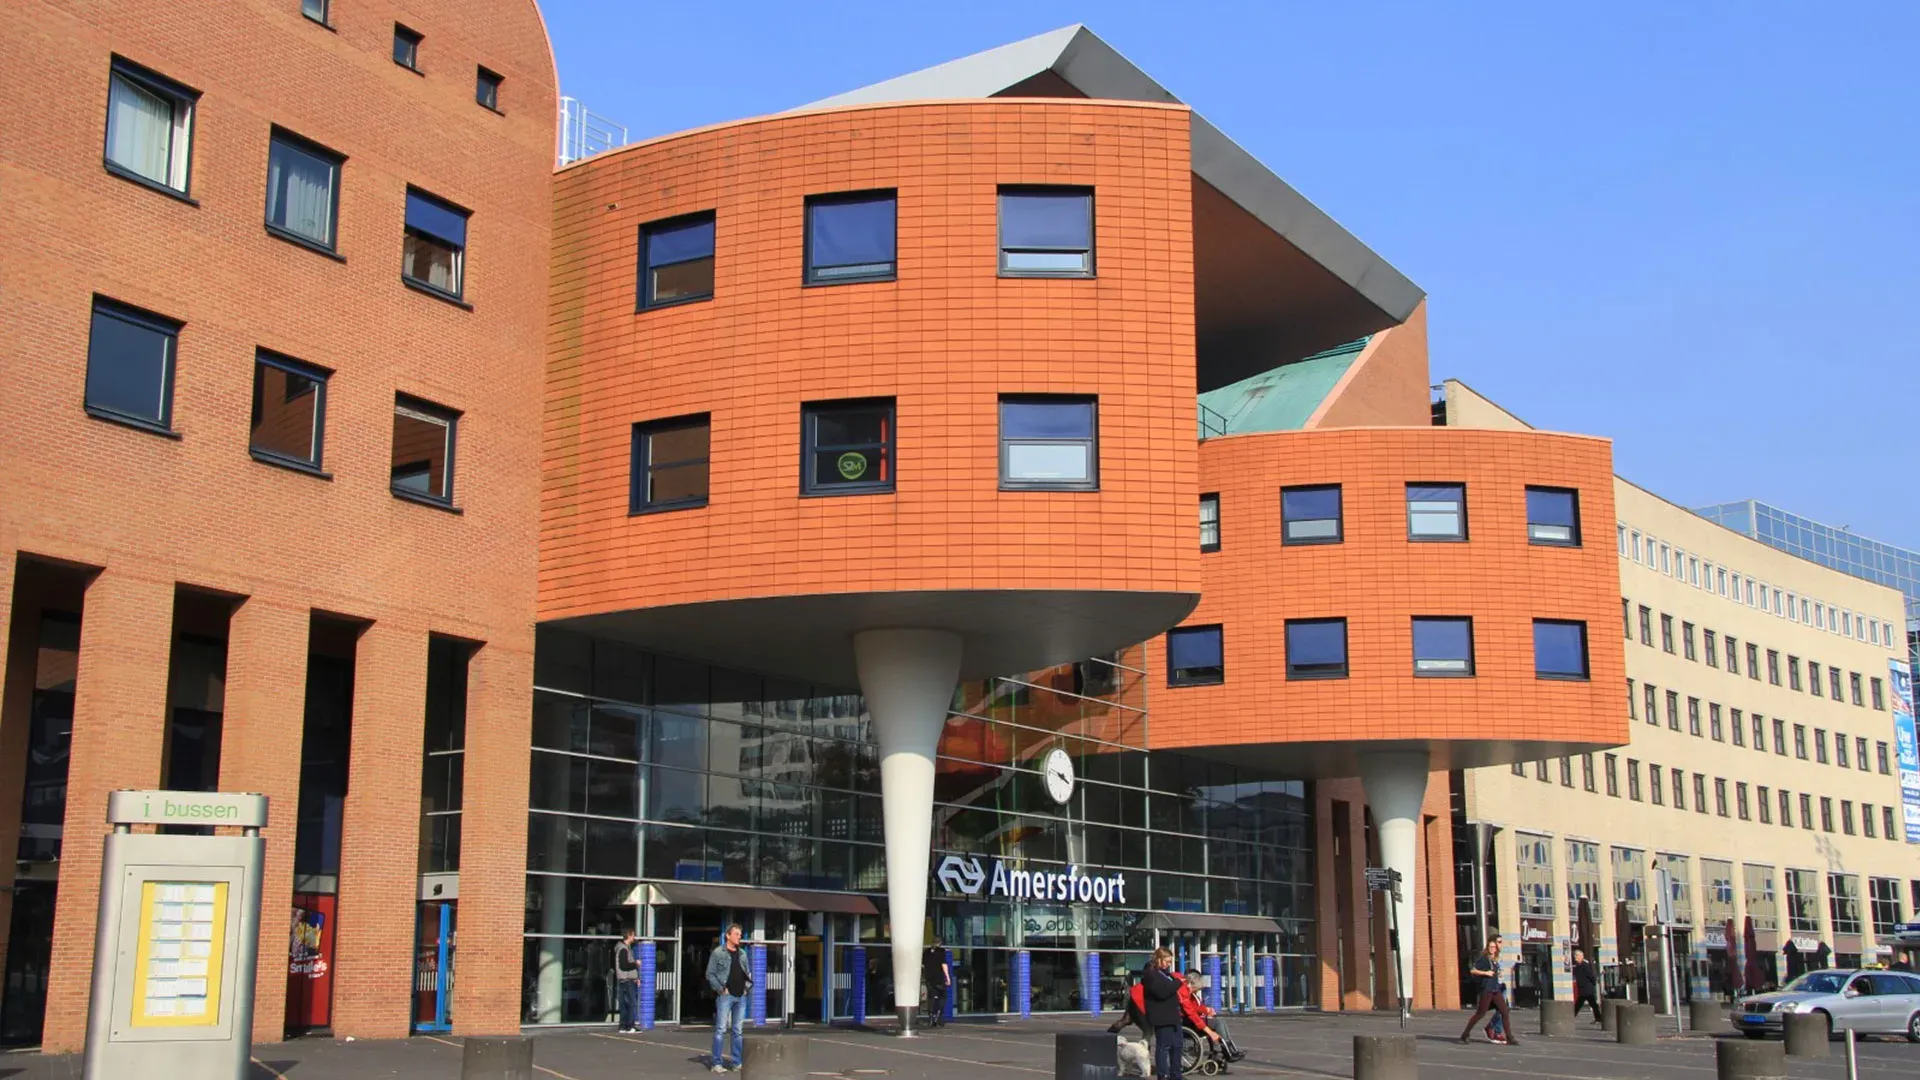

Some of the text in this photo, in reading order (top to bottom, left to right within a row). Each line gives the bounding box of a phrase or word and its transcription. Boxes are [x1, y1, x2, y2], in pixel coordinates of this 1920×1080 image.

[164, 800, 238, 819] bussen
[990, 860, 1126, 904] Amersfoort
[1046, 919, 1124, 932] OUDSOORN
